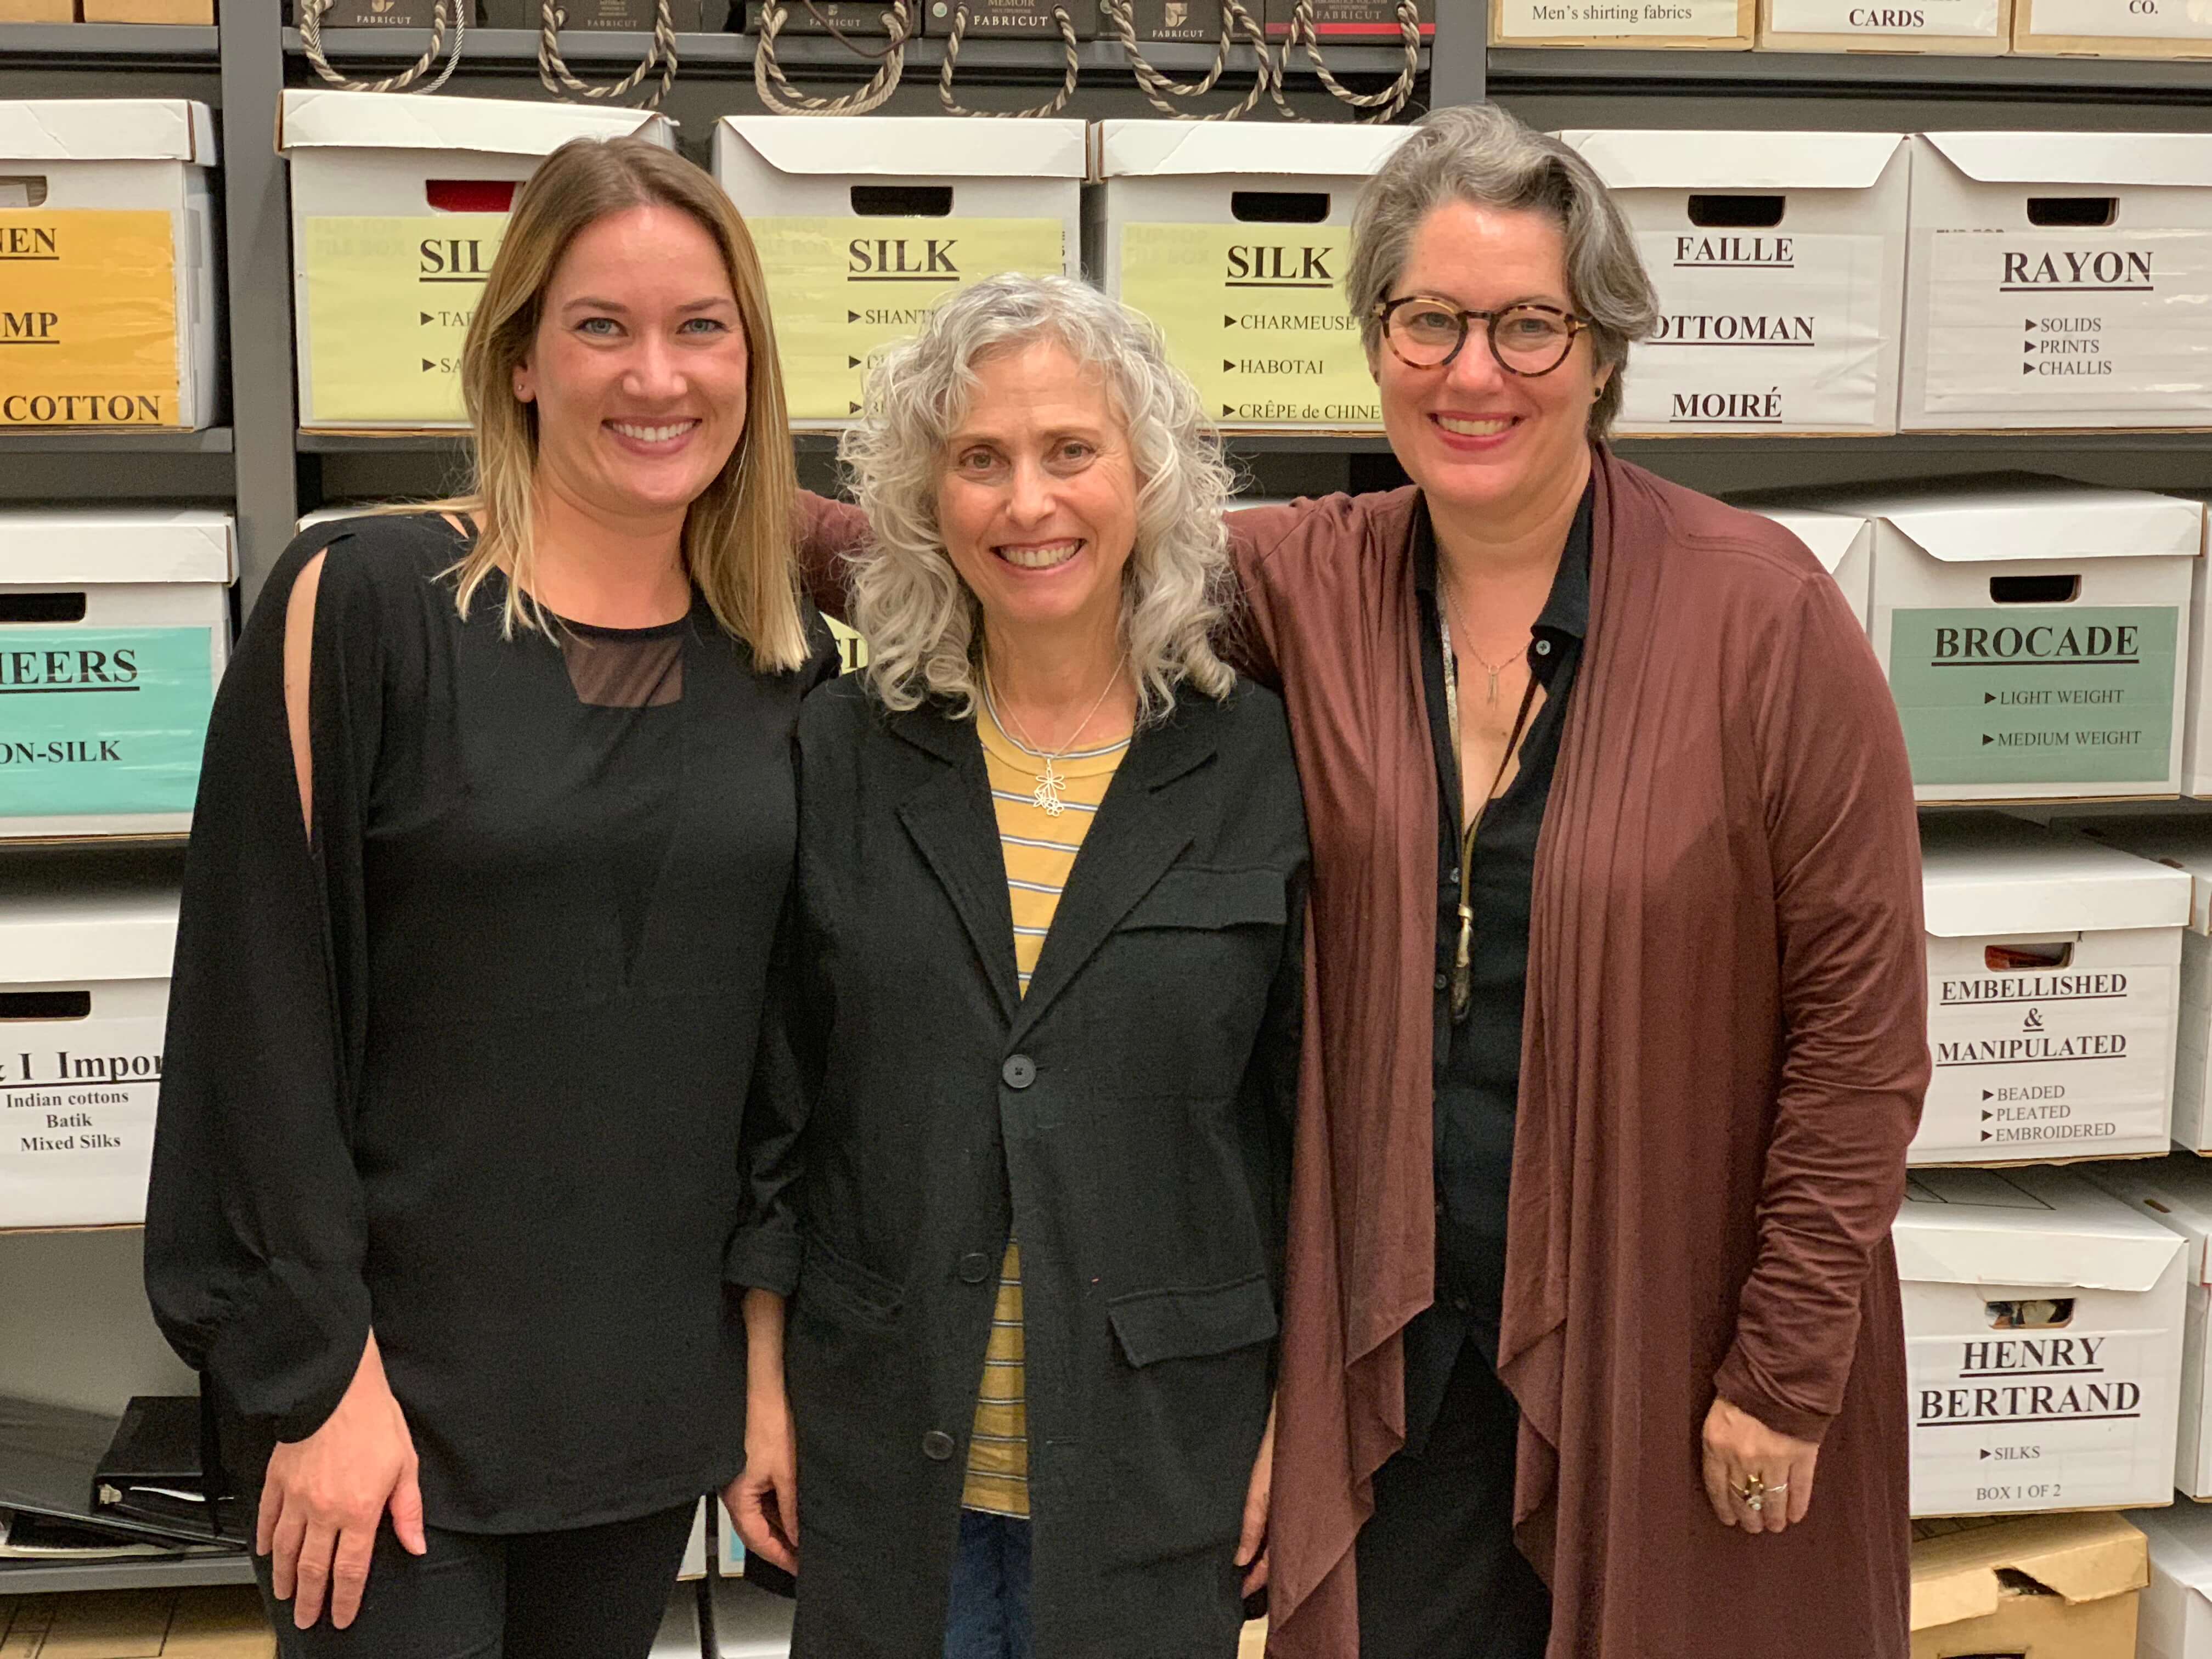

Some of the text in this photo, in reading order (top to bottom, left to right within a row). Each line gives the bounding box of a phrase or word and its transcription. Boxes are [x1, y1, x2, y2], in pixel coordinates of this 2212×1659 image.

[1317, 11, 1381, 19] FABRICUT
[1583, 4, 1639, 23] shirting
[1644, 4, 1692, 19] fabrics
[2129, 0, 2158, 14] CO.
[357, 15, 411, 24] FABRICUT
[810, 18, 861, 26] FARICUT
[974, 15, 1048, 26] FABRICUT
[1848, 8, 1925, 27] CARDS
[0, 228, 57, 253] EN
[1676, 236, 1793, 262] FAILLE
[420, 239, 504, 274] SIL
[848, 239, 960, 273] SILK
[1227, 245, 1334, 279] SILK
[2001, 251, 2154, 283] RAYON
[1240, 315, 1356, 330] CHARMEUSE
[2040, 318, 2102, 332] SOLIDS
[2039, 340, 2100, 354] PRINTS
[1240, 360, 1323, 374] HABOTAI
[2038, 360, 2112, 376] CHALLIS
[3, 395, 161, 422] COTTON
[1239, 400, 1381, 419] CRÊPE de CHINE
[1672, 386, 1782, 418] MOIRÉ
[1934, 625, 2139, 658] BROCADE
[0, 650, 138, 685] EERS
[2000, 689, 2125, 706] LIGHT WEIGHT
[1997, 730, 2142, 747] MEDIUM WEIGHT
[1942, 973, 2127, 1001] EMBELLISHED
[2023, 1007, 2044, 1028] &
[1936, 1034, 2127, 1062] MANIPULATED
[18, 1053, 34, 1080] I
[6, 1092, 129, 1108] Indian cottons
[1996, 1085, 2066, 1102] BEADED
[46, 1113, 93, 1128] Batik
[1996, 1104, 2071, 1121] PLEATED
[1995, 1122, 2116, 1142] EMBROIDERED
[20, 1133, 121, 1152] Mixed Silks
[1962, 1337, 2106, 1370] HENRY
[1917, 1382, 2141, 1419] BERTRAND
[1994, 1446, 2041, 1461] SILKS
[1976, 1485, 2011, 1502] BOX
[2028, 1483, 2050, 1498] OF
[2053, 1483, 2062, 1497] 2
